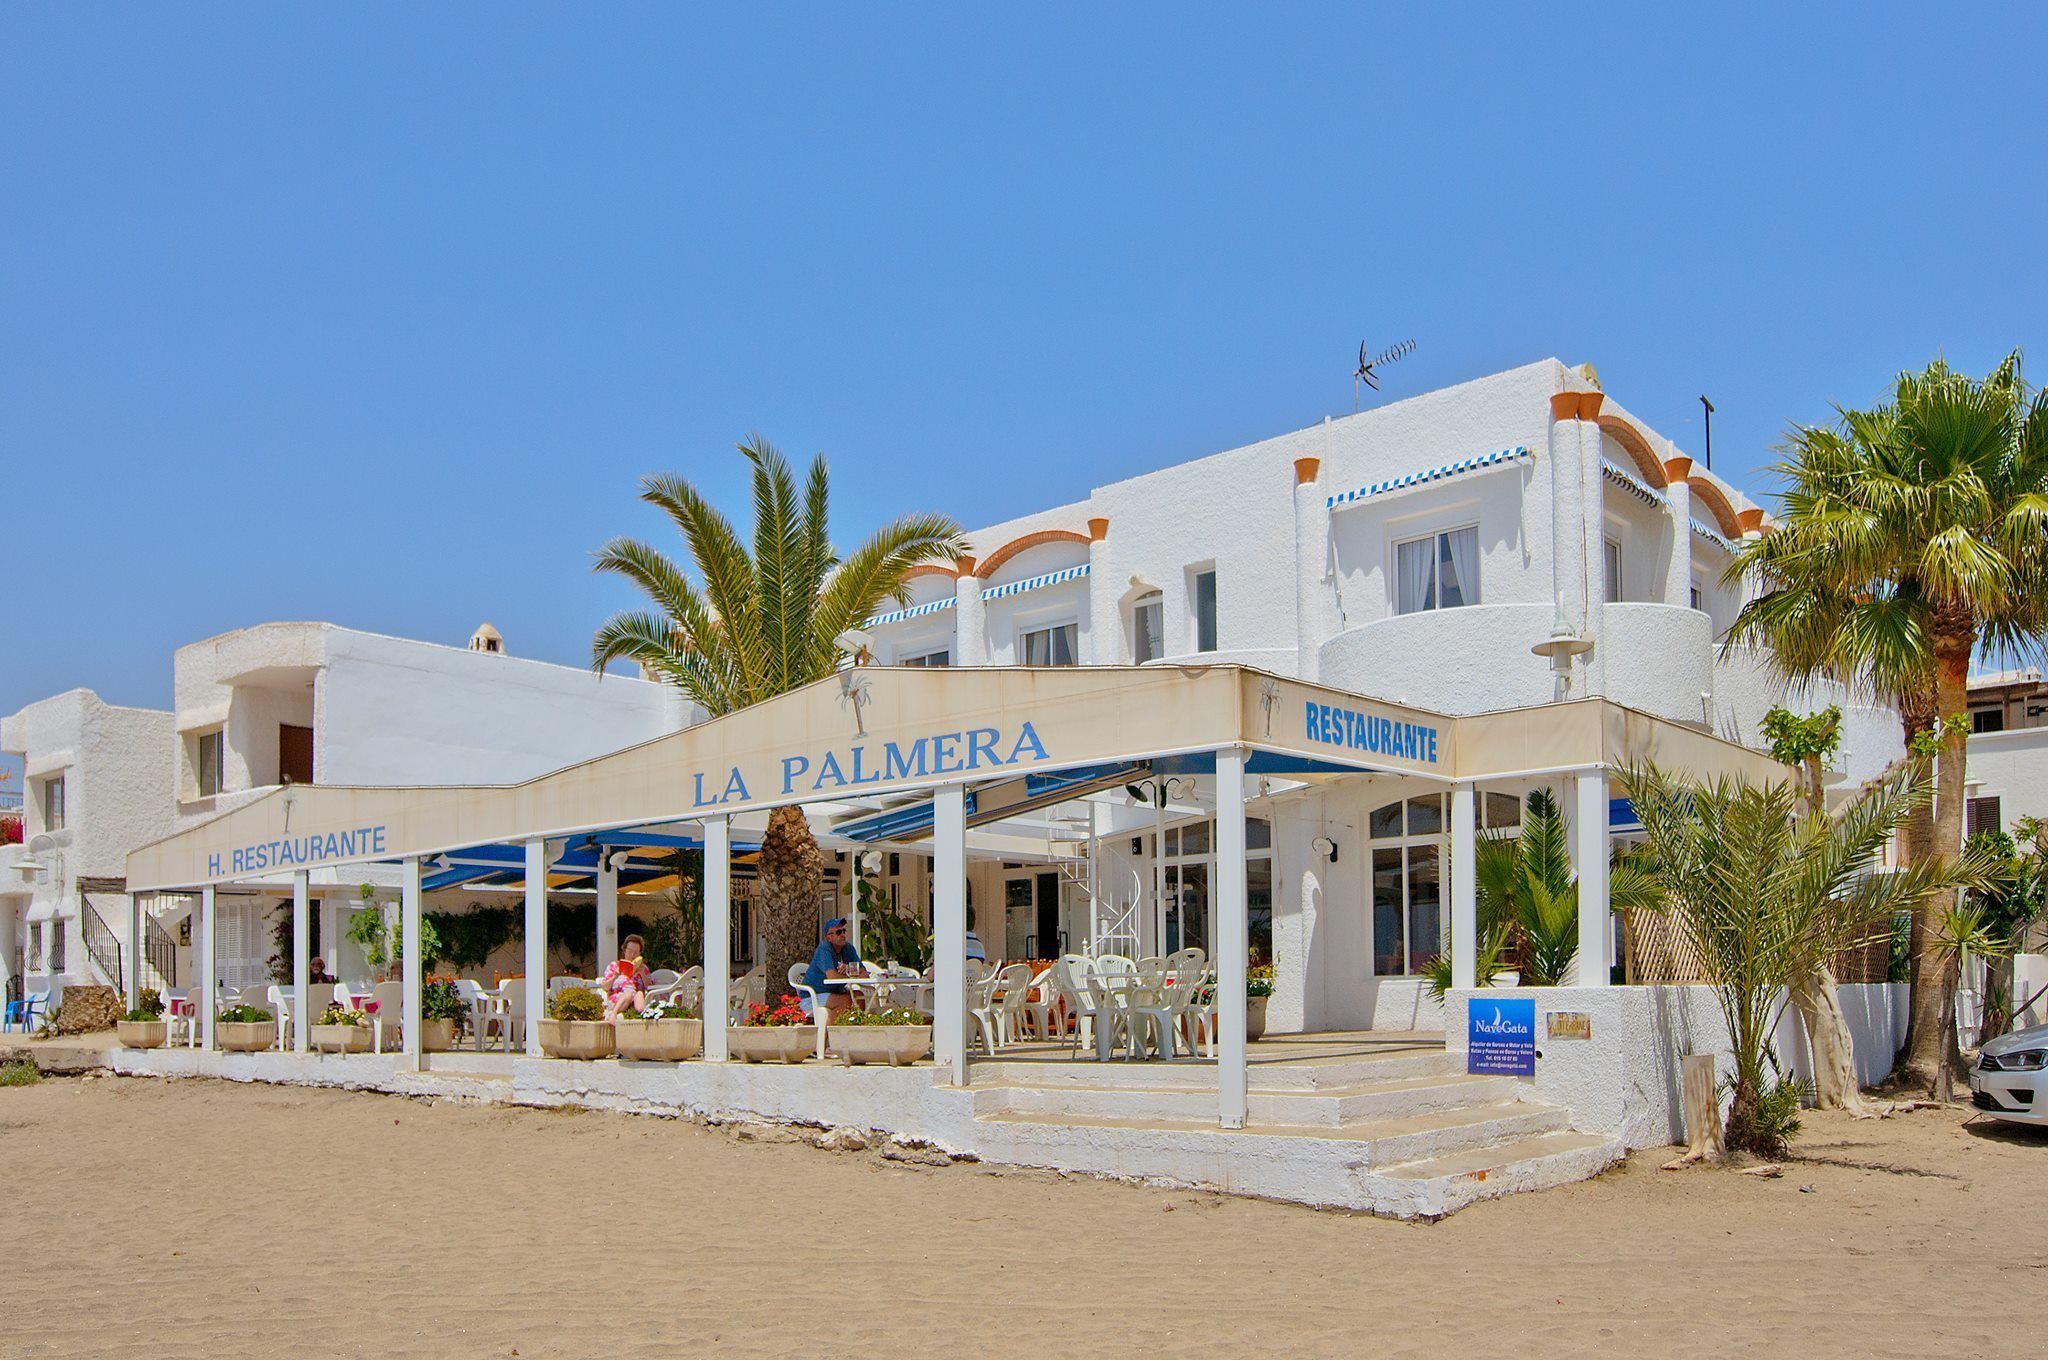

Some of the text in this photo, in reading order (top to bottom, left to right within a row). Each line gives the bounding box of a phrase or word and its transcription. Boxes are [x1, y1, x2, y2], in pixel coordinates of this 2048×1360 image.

[1306, 701, 1437, 763] RESTAURANTE
[692, 721, 1050, 808] LA PALMERA
[208, 826, 386, 877] H. RESTAURANTE
[1475, 1020, 1528, 1034] NaveGata
